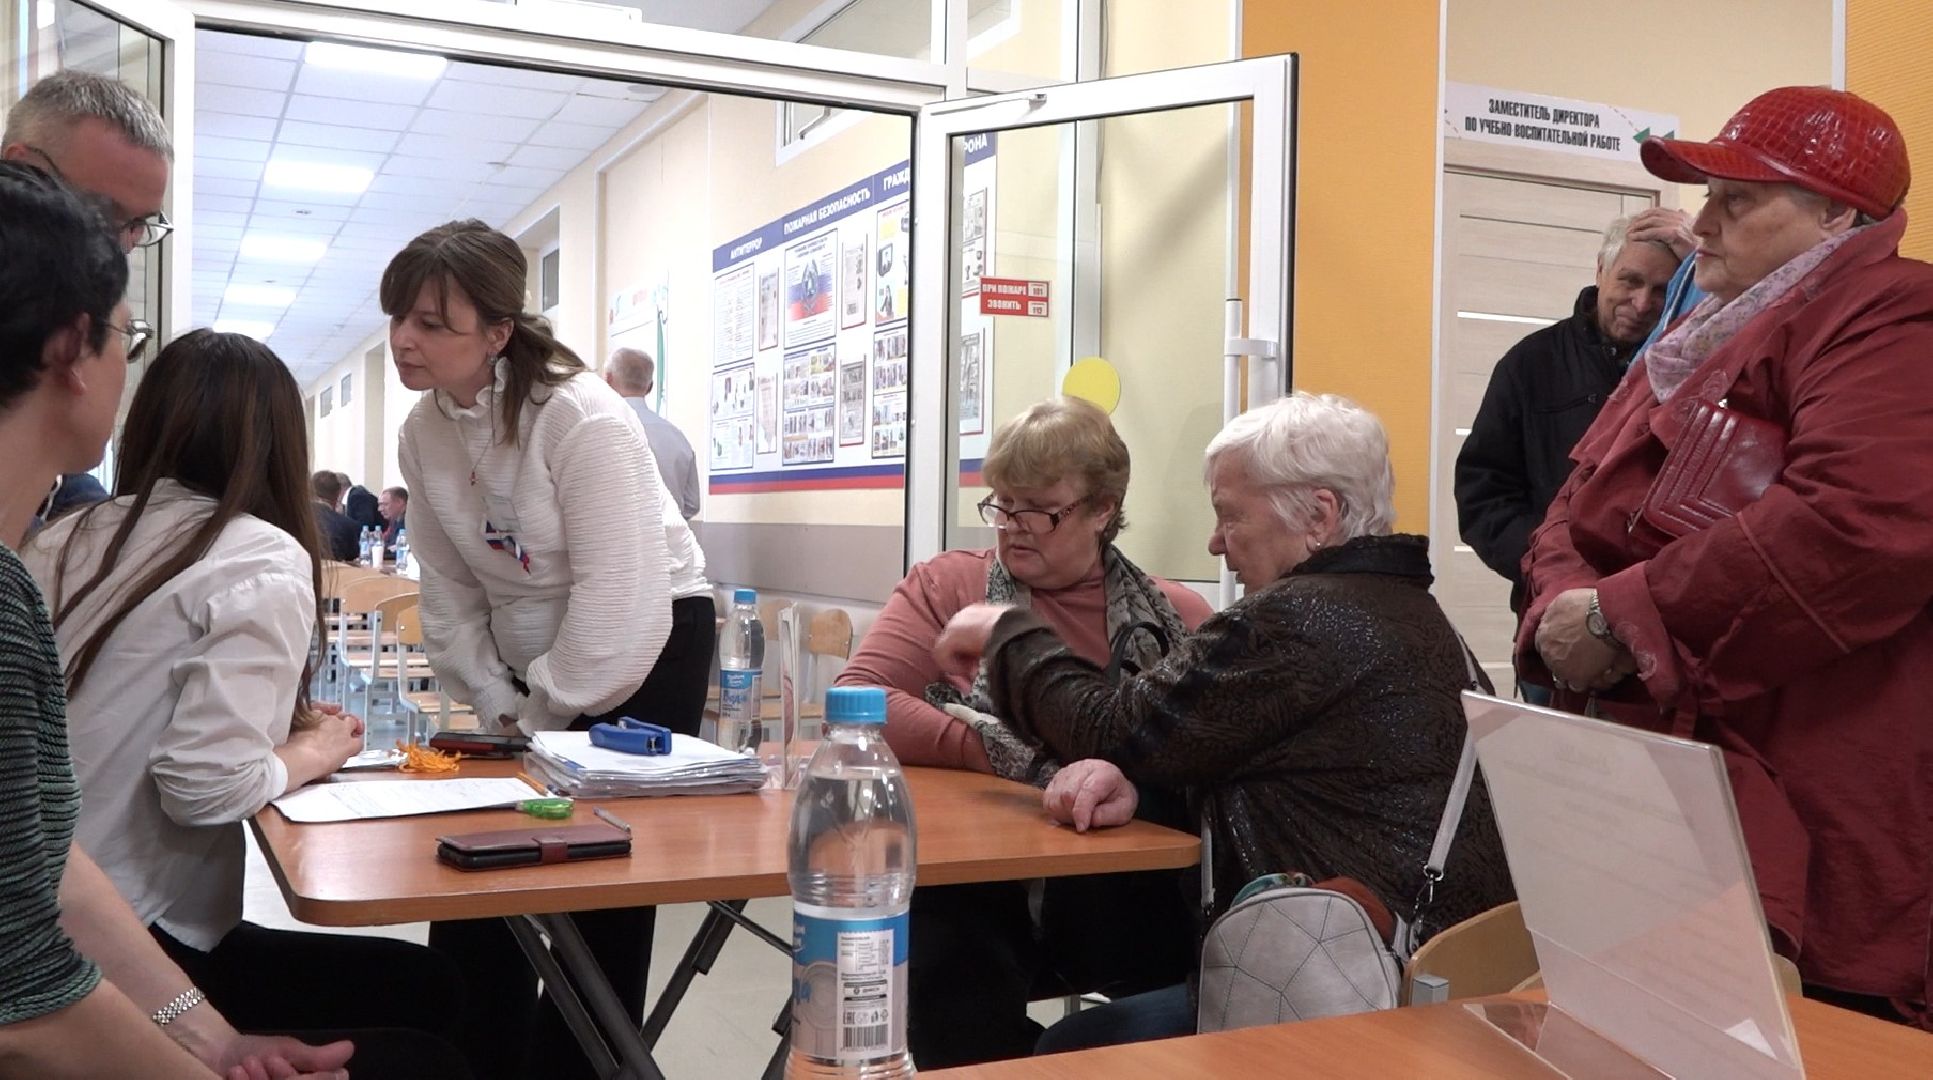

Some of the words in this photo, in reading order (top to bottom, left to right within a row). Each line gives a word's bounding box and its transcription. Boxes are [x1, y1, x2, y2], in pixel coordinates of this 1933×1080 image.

[1488, 98, 1551, 121] ЗАМЕСТИТЕЛЬ
[1552, 108, 1600, 128] ДИРЕКТОРА
[1464, 116, 1477, 132] ПО
[1479, 117, 1512, 136] УЧЕБНО
[1514, 123, 1588, 147] ВОСПИТАТЕЛЬНОЙ
[1590, 132, 1621, 151] РАБОТЕ
[783, 209, 818, 235] ПОЖАРНАЯ
[818, 187, 871, 221] БЕЗОПАСНОСТЬ
[982, 283, 997, 293] ПРИ
[997, 284, 1027, 296] ПОЖАРЕ
[987, 299, 1022, 311] ЗВОНИТЬ
